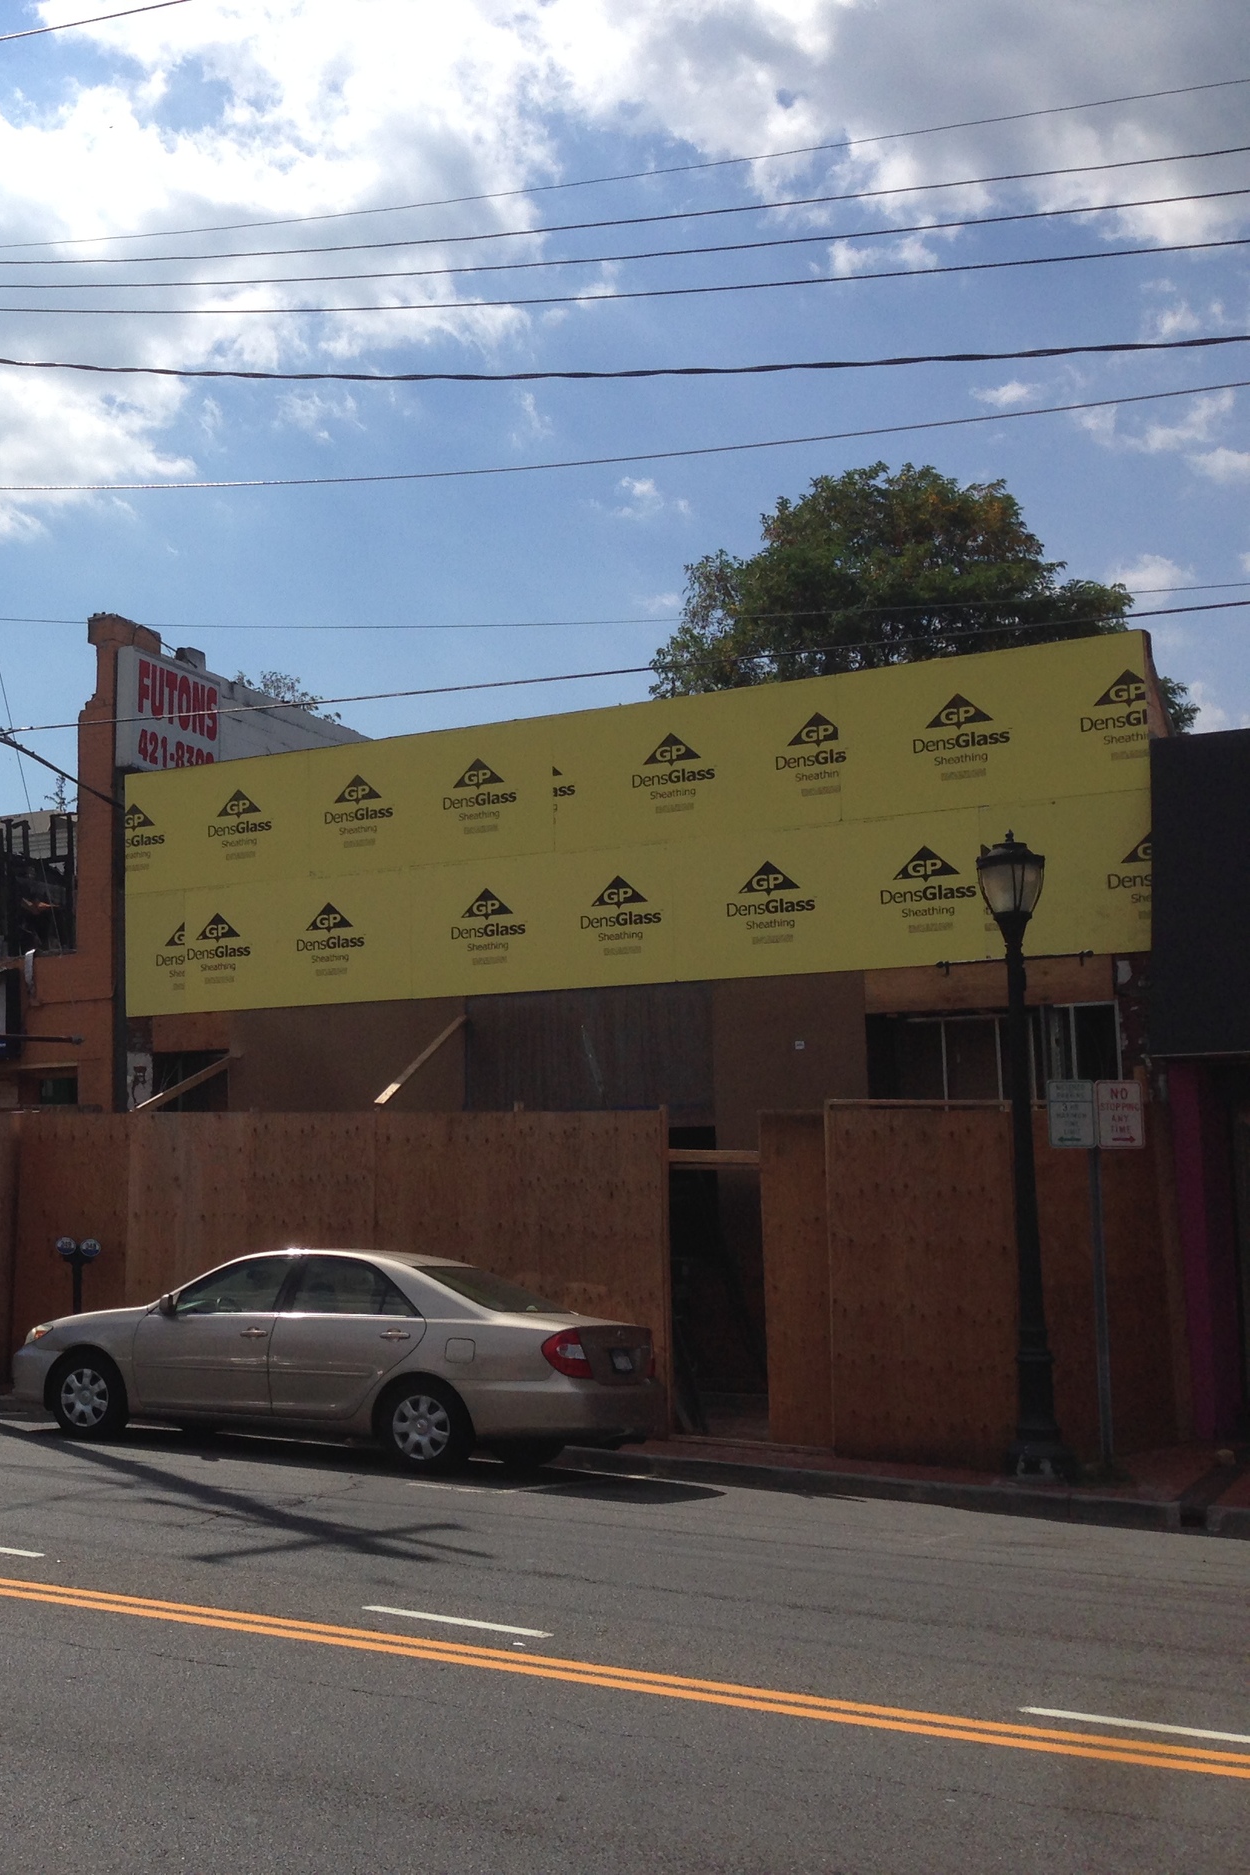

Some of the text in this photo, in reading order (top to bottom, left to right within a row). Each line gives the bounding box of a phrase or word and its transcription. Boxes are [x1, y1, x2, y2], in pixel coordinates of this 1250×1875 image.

[138, 658, 218, 741] FUTONS
[1108, 683, 1146, 702] GP
[939, 706, 976, 724] GP
[800, 725, 834, 742] GP
[912, 731, 1010, 754] DensGlass
[655, 745, 687, 761] GP
[933, 752, 988, 766] Sheathing
[463, 770, 492, 785] GP
[631, 767, 715, 789] DensGlass
[343, 785, 371, 800] GP
[650, 787, 696, 800] Sheathing
[226, 799, 251, 814] GP
[442, 791, 517, 811] DensGlass
[324, 806, 394, 825] DensGlass
[458, 810, 500, 822] Sheathing
[207, 820, 272, 838] DensGlass
[339, 824, 378, 836] Sheathing
[221, 837, 258, 849] Sheathing
[907, 859, 943, 877] GP
[751, 873, 784, 890] GP
[602, 887, 633, 904] GP
[880, 884, 977, 904] DensGlass
[471, 900, 500, 916] GP
[726, 898, 816, 917] DensGlass
[901, 905, 955, 918] Sheathing
[315, 913, 341, 929] GP
[580, 911, 662, 930] DensGlass
[746, 918, 795, 930] Sheathing
[204, 925, 229, 938] GP
[451, 922, 526, 940] DensGlass
[597, 930, 643, 942] Sheathing
[296, 935, 365, 953] DensGlass
[466, 941, 509, 952] Sheathing
[186, 945, 251, 962] DensGlass
[311, 953, 349, 965] Sheathing
[200, 961, 236, 973] Sheathing
[1110, 1087, 1128, 1100] NO
[1062, 1103, 1068, 1112] 3
[1100, 1102, 1140, 1112] STOPPING
[1111, 1114, 1129, 1122] ANY
[1110, 1125, 1130, 1133] TIME
